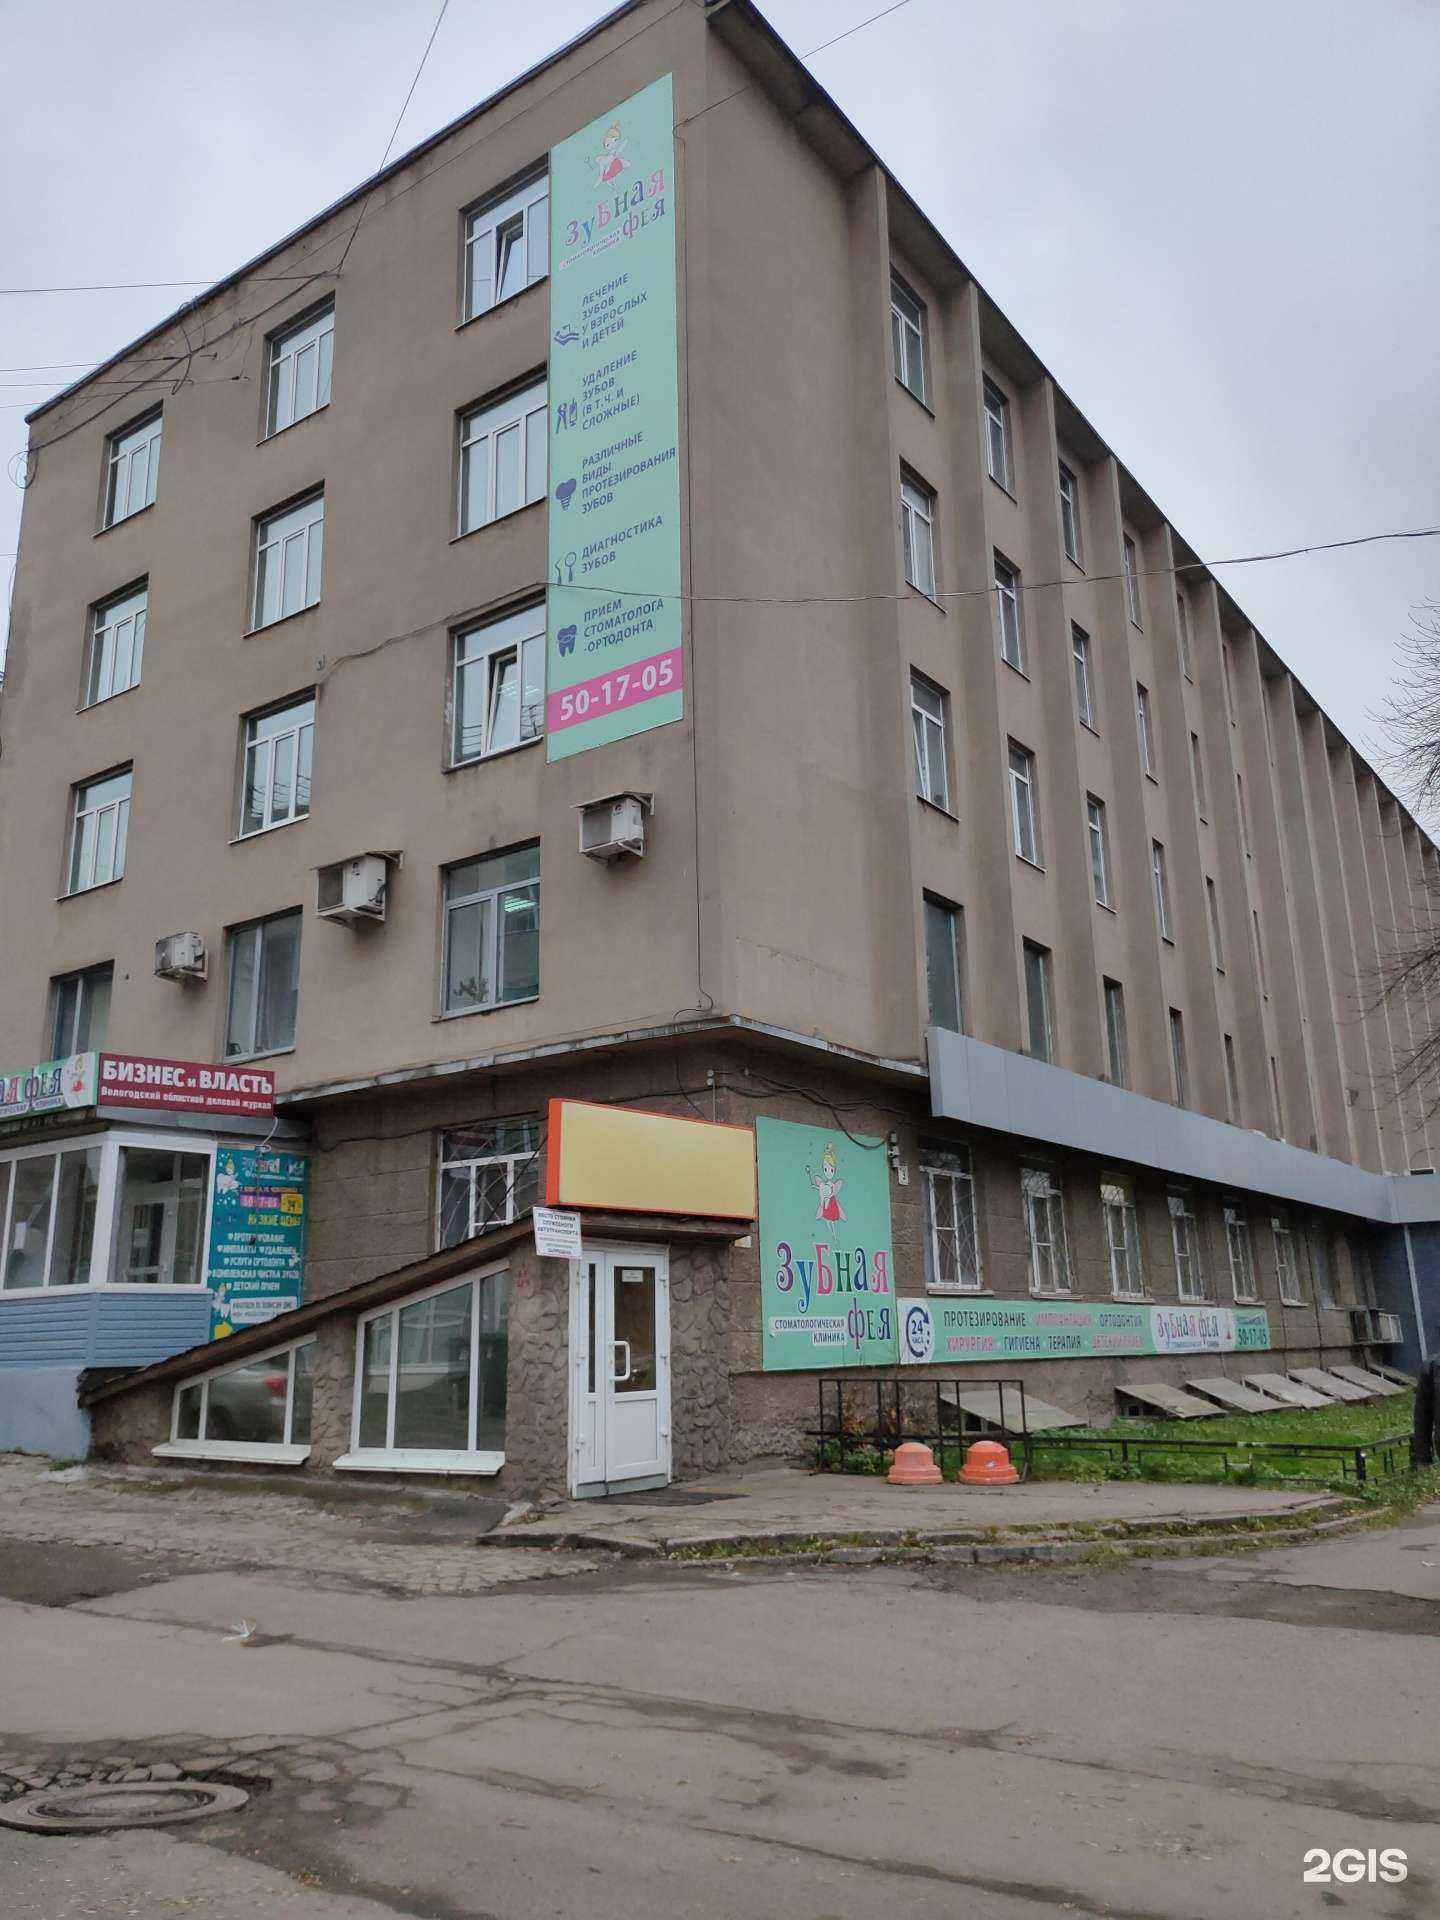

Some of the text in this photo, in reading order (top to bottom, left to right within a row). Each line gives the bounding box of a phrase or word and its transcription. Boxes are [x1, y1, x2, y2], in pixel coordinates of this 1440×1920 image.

[582, 273, 629, 307] ЛЕЧЕНИЕ
[582, 296, 615, 320] ЗУБОВ
[582, 291, 647, 335] У ВЗРОСЛЫХ
[582, 316, 625, 349] И ДЕТЕЙ
[582, 350, 637, 387] УДАЛЕНИЕ
[582, 377, 615, 402] ЗУБОВ
[616, 387, 624, 398] И
[582, 393, 640, 430] СЛОЖНЫЕ)
[582, 432, 643, 468] РАЗЛИЧНЫЕ
[582, 447, 676, 499] ПРОТЕЗИРОВАНИЯ
[581, 492, 614, 514] ЗУБОВ
[582, 515, 663, 560] ДИАГНОСТИКА
[581, 551, 616, 574] ЗУБОВ
[584, 599, 621, 622] ПРИЕМ
[584, 598, 664, 637] СТОМАТОЛОГА
[560, 659, 673, 720] 50-17-05
[103, 1060, 186, 1088] БИЗНЕС
[200, 1070, 273, 1095] ВЛАСТЬ
[101, 1086, 272, 1110] Вологодский областной деловой журнал
[774, 1317, 845, 1330] СТОМАТОЛОГИЧЕСКАЯ
[911, 1319, 924, 1335] 24
[944, 1310, 1027, 1327] ПРОТЕЗИРОВАНИЕ
[813, 1332, 845, 1344] КЛИНИКА
[946, 1335, 993, 1352] ХИРУРГИЯ
[1003, 1335, 1041, 1351] ГИГИЕНА
[1047, 1335, 1081, 1351] ТЕРАПИЯ
